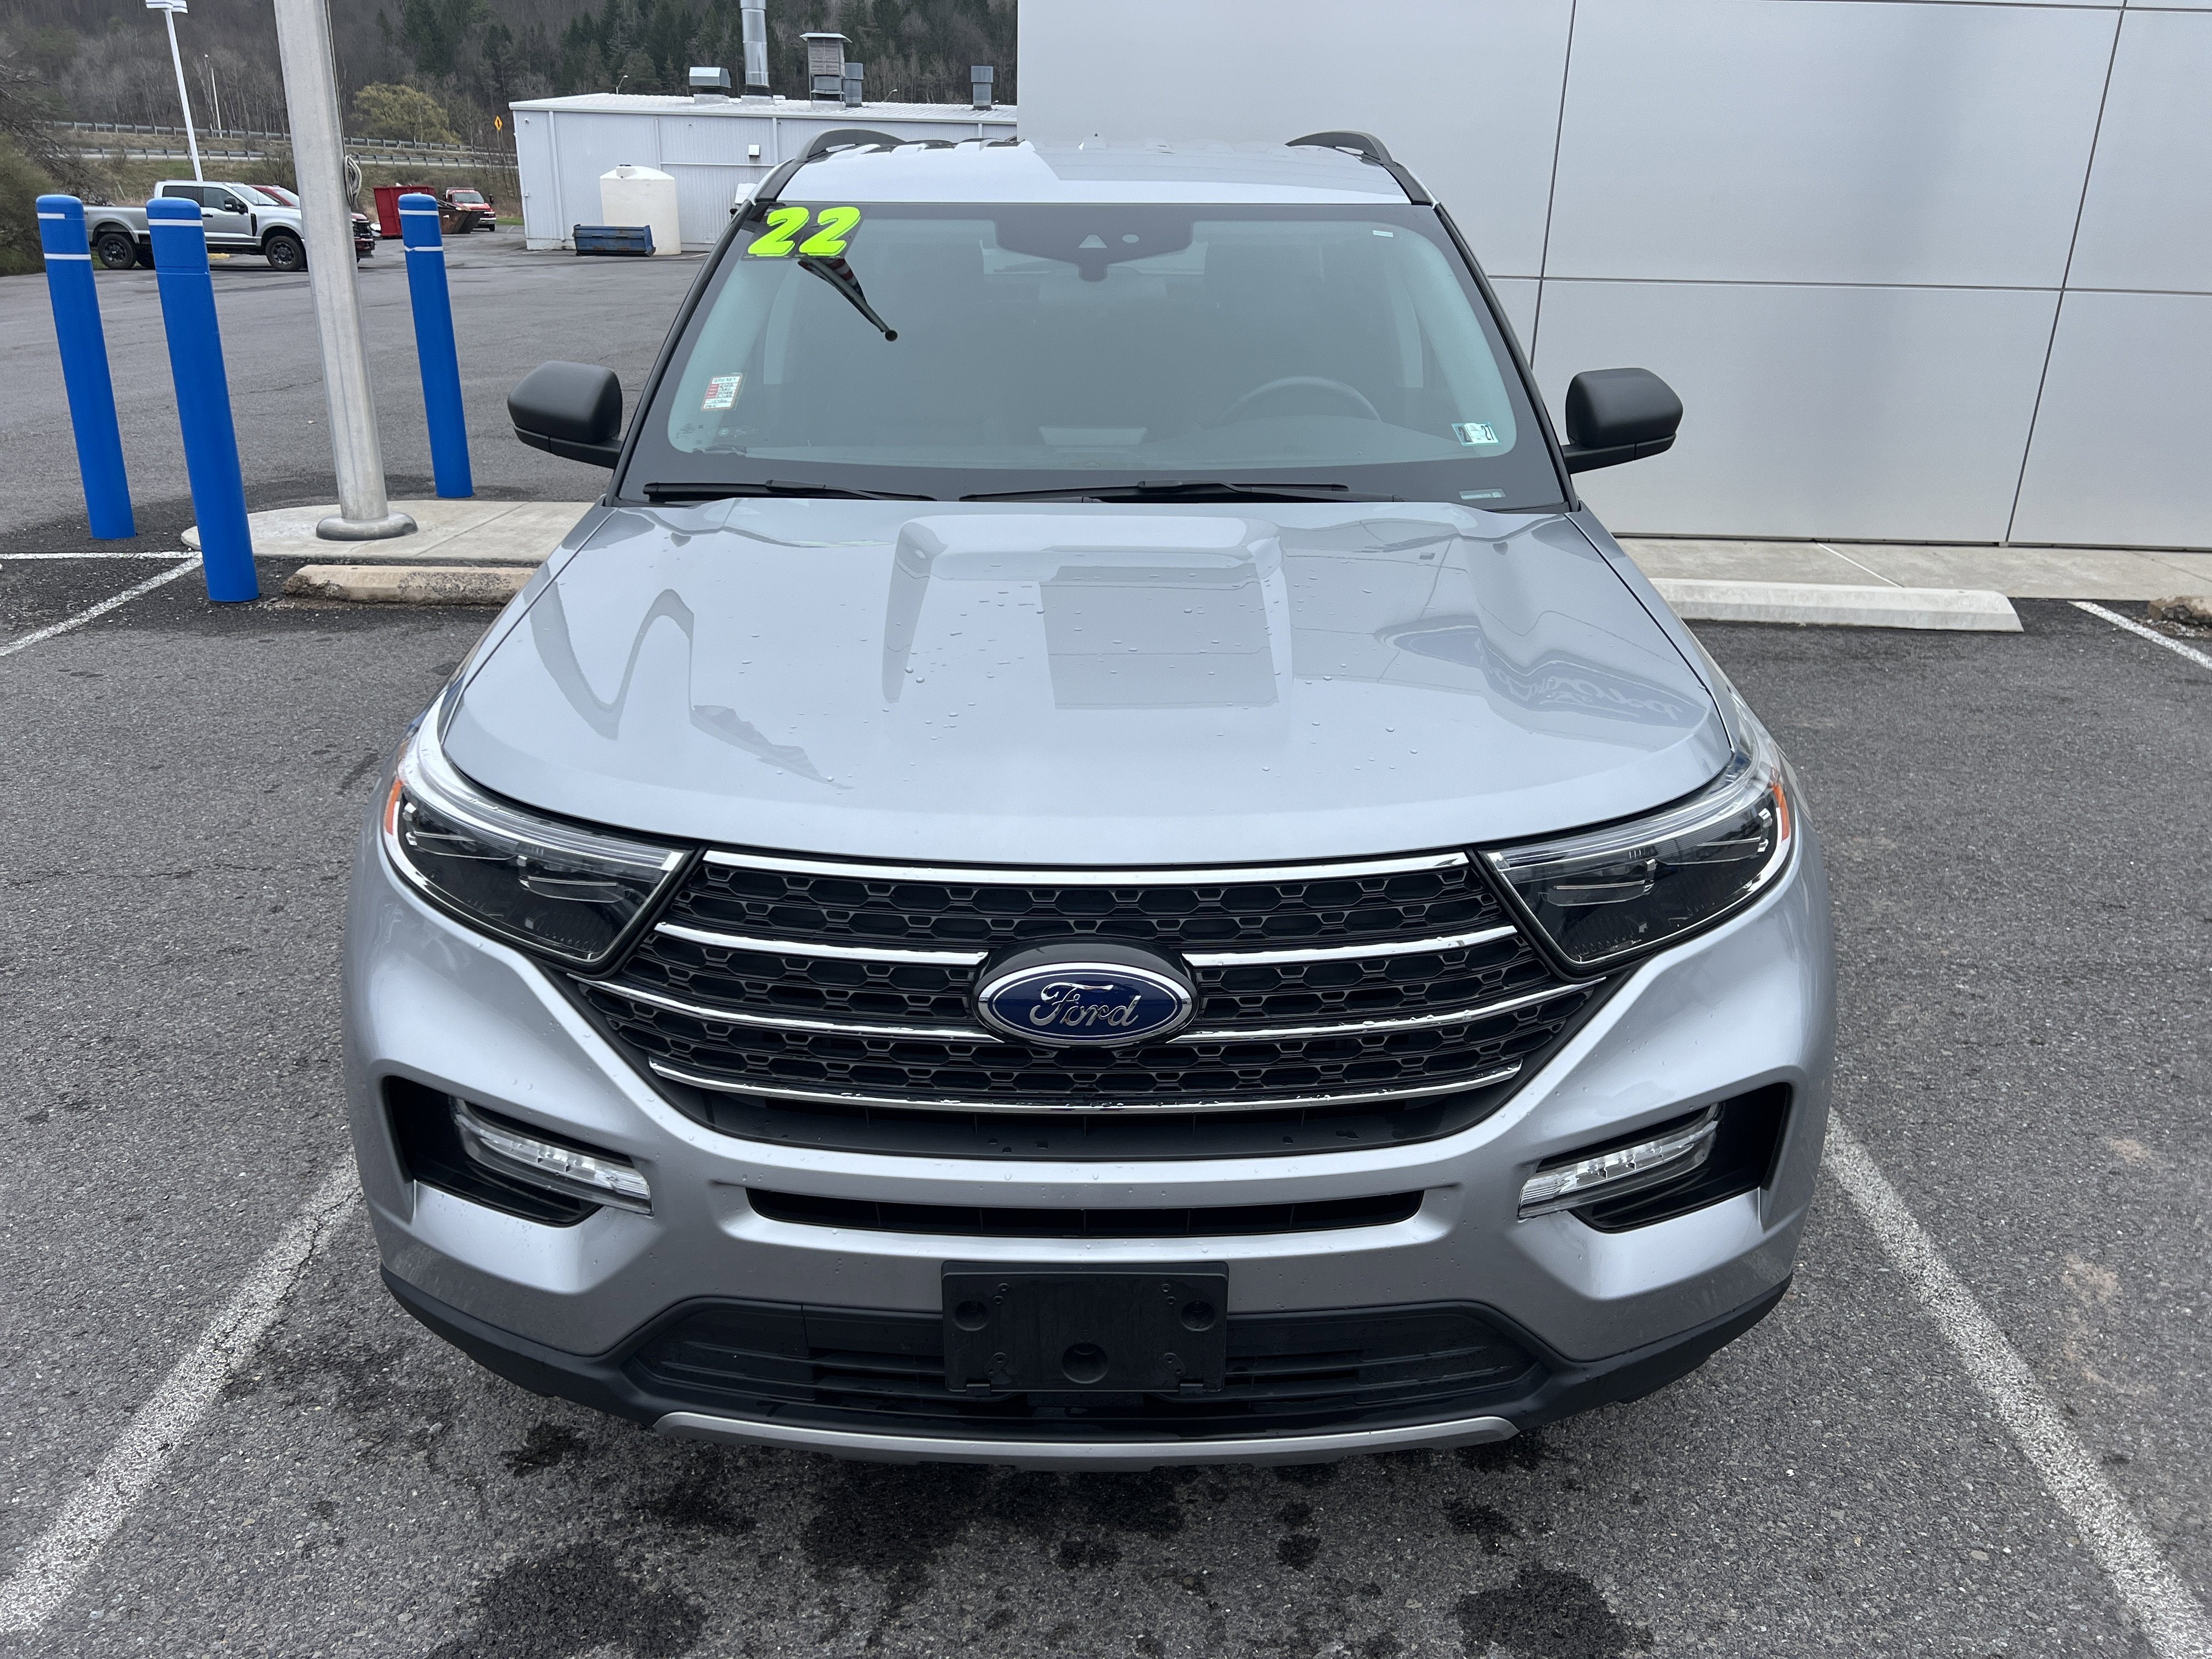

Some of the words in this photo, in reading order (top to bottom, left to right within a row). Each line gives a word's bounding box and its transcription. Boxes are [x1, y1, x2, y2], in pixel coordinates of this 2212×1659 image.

[748, 206, 861, 257] 22
[1481, 425, 1494, 441] 27
[1030, 982, 1142, 1026] Ford
